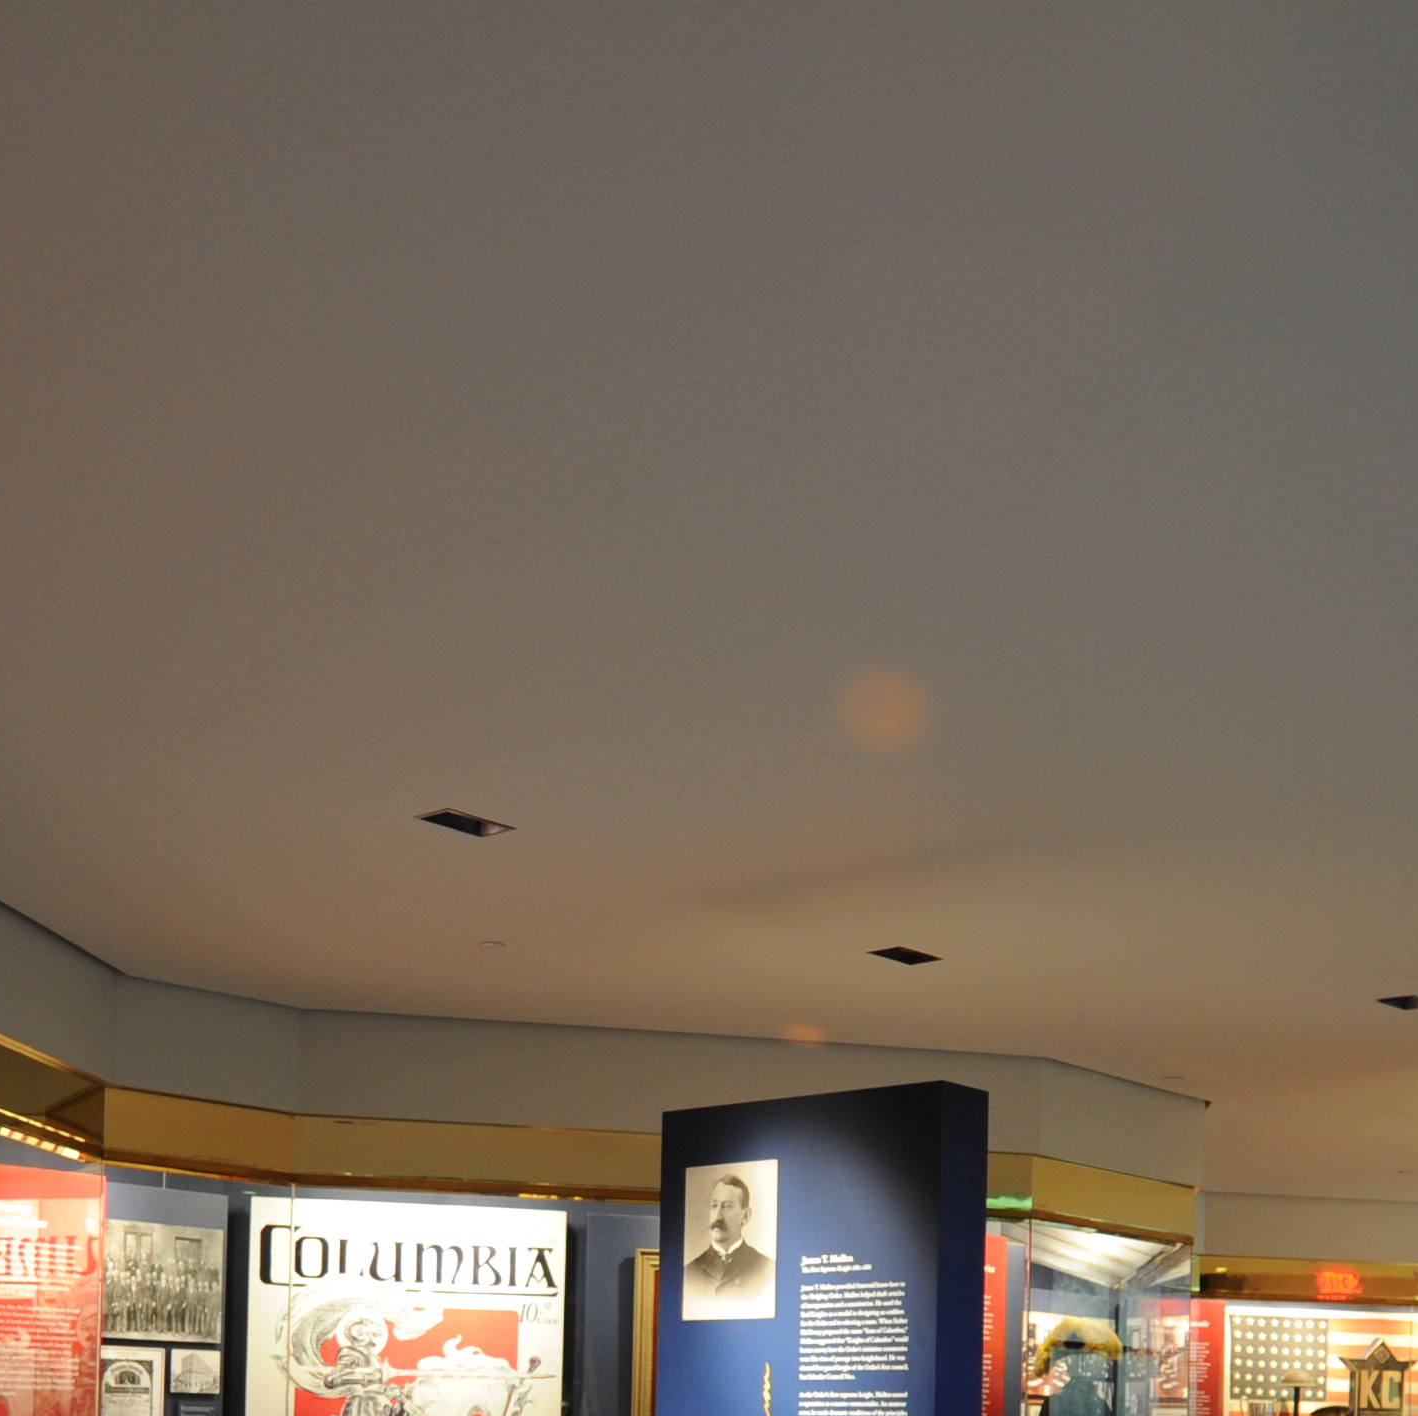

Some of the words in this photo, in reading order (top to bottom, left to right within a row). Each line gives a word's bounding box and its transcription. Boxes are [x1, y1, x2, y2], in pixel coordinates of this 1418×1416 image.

[259, 1223, 559, 1289] COLUMBIA
[520, 1303, 538, 1322] 10
[1359, 1369, 1402, 1409] KC
